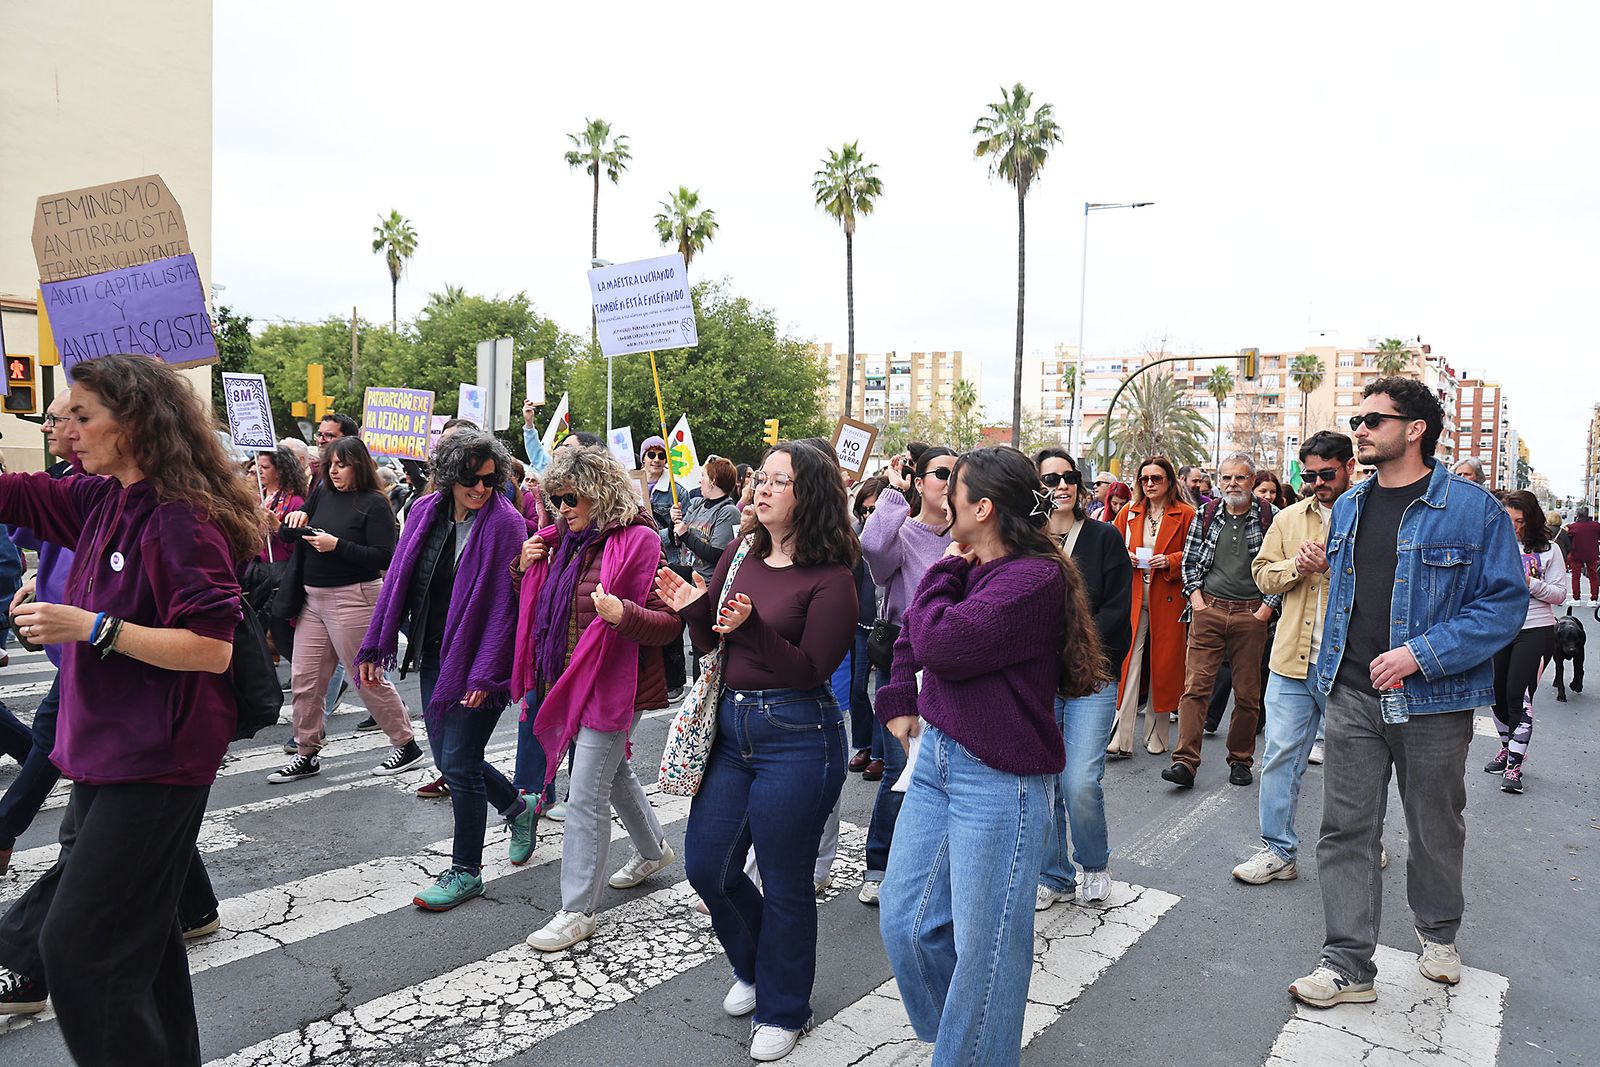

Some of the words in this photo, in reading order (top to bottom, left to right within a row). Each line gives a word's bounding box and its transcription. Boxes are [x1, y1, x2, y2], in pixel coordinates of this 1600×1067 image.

[41, 182, 160, 226] FEMINISMO
[43, 210, 180, 259] ANTIRRACISTA
[50, 285, 88, 306] ANTI
[95, 262, 197, 300] CAPITALISTA
[597, 280, 606, 292] LA
[606, 275, 640, 290] MAESTRA
[639, 267, 674, 284] LUCHANDO
[113, 300, 126, 321] Y
[625, 292, 643, 309] ESTÁ
[233, 388, 252, 402] 8M
[366, 410, 377, 429] HA
[378, 411, 410, 432] DEJADO
[413, 415, 426, 434] DE
[363, 431, 426, 459] FUNCIONAR
[843, 439, 859, 451] NO
[848, 450, 856, 458] LA
